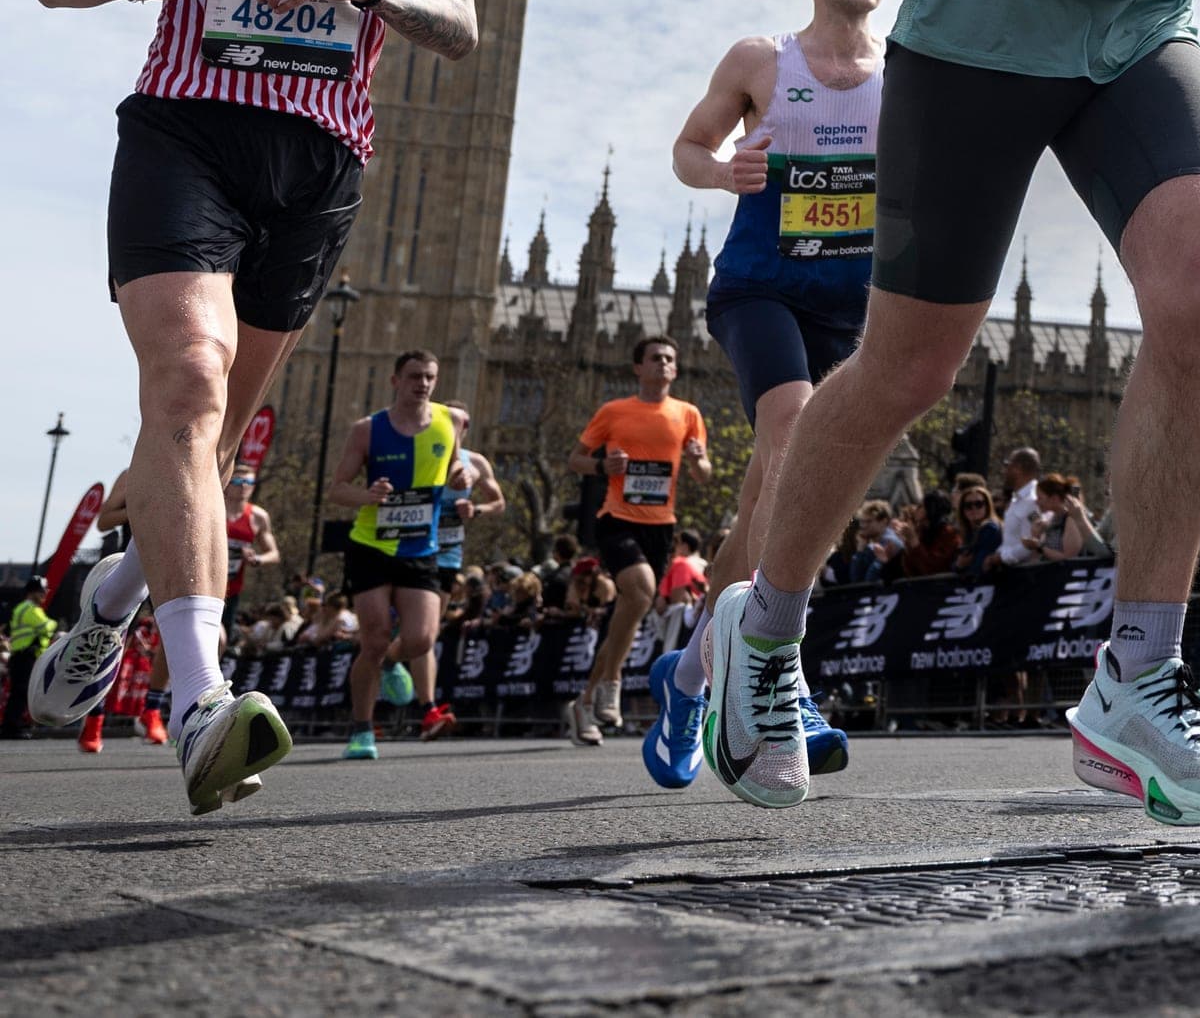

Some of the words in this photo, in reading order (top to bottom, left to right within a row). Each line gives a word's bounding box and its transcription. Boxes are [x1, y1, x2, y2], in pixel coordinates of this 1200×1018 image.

[263, 60, 290, 70] new
[291, 60, 338, 75] balance
[813, 124, 867, 136] clapham
[817, 135, 863, 146] chasers
[789, 166, 827, 188] tcs
[831, 173, 876, 181] CONSULTANC
[804, 202, 860, 227] 4551
[840, 246, 874, 254] balance
[911, 651, 935, 668] new
[937, 646, 992, 667] balance
[1026, 642, 1057, 661] new
[1058, 636, 1102, 659] balan
[821, 661, 840, 676] new
[841, 654, 885, 674] balance
